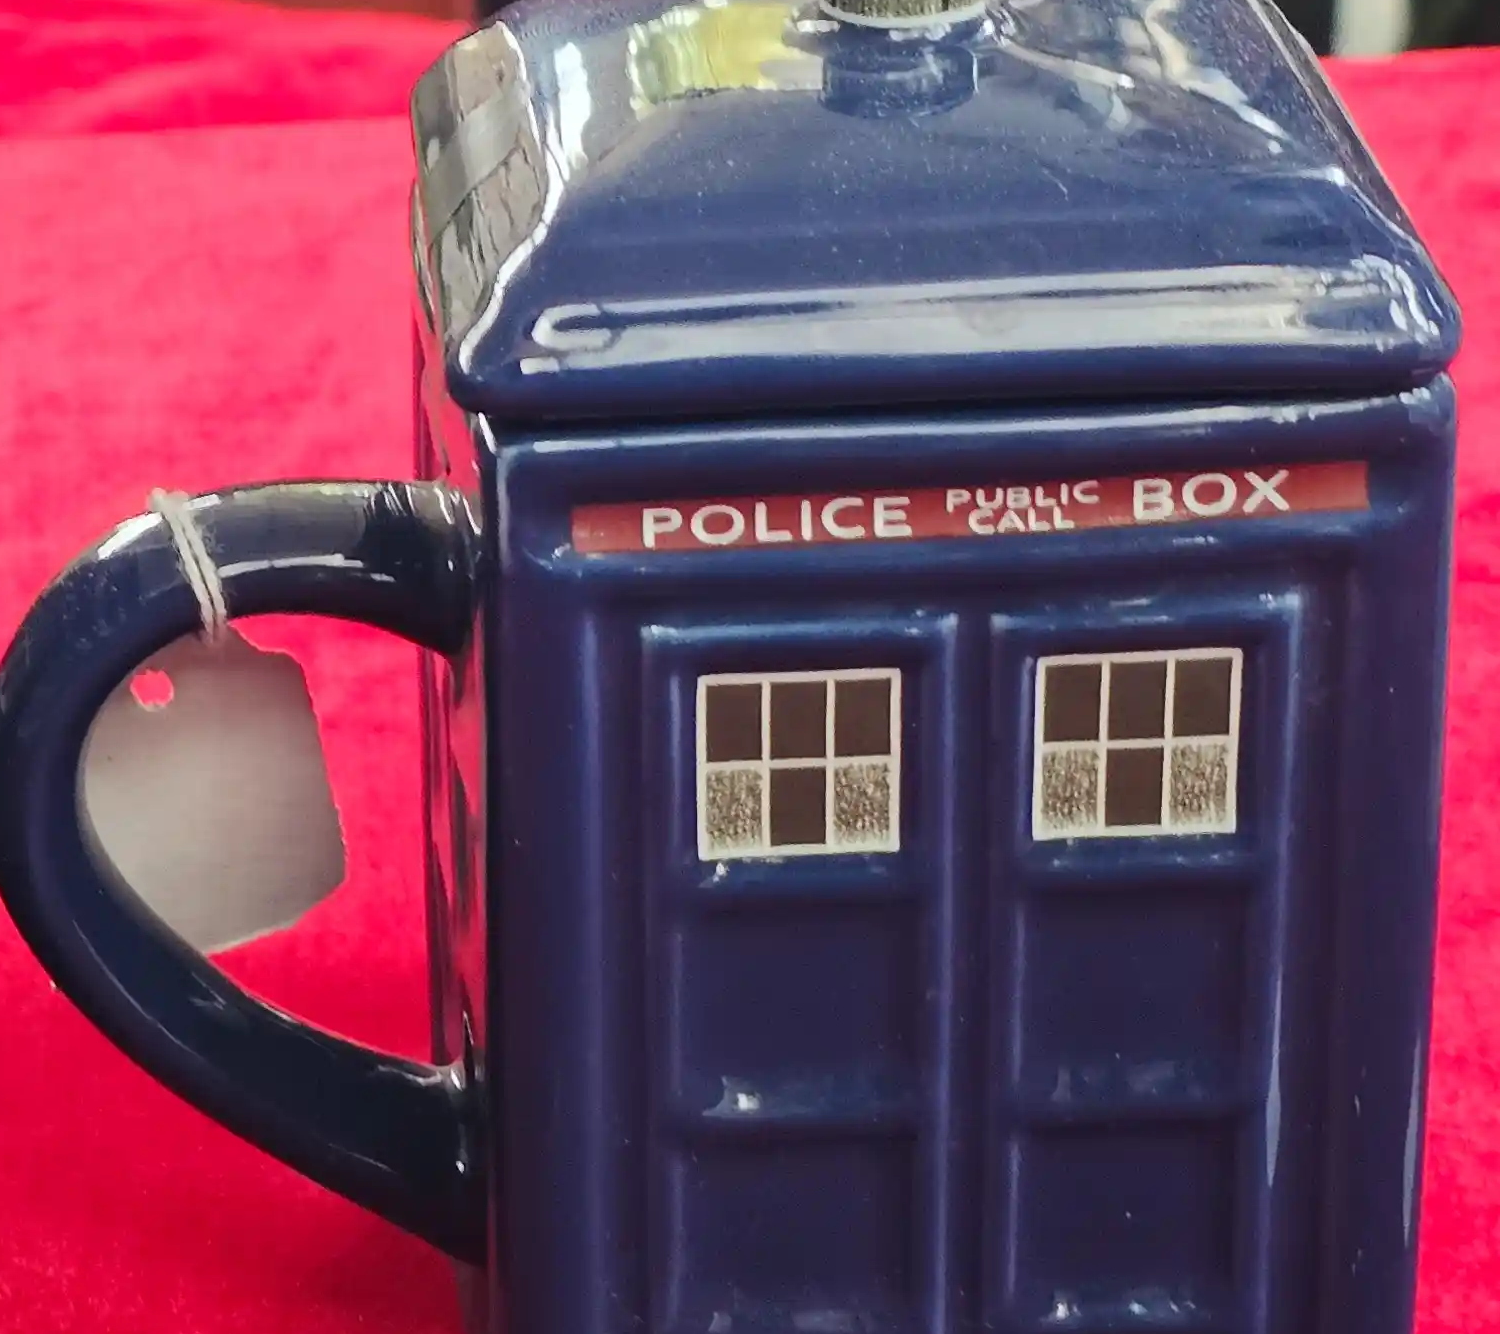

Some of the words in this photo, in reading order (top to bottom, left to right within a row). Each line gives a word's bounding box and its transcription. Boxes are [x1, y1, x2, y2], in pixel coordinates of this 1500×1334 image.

[946, 480, 1099, 513] PUBLIC
[1132, 469, 1290, 523] BOX
[642, 496, 913, 550] POLICE
[968, 506, 1076, 535] CALL
